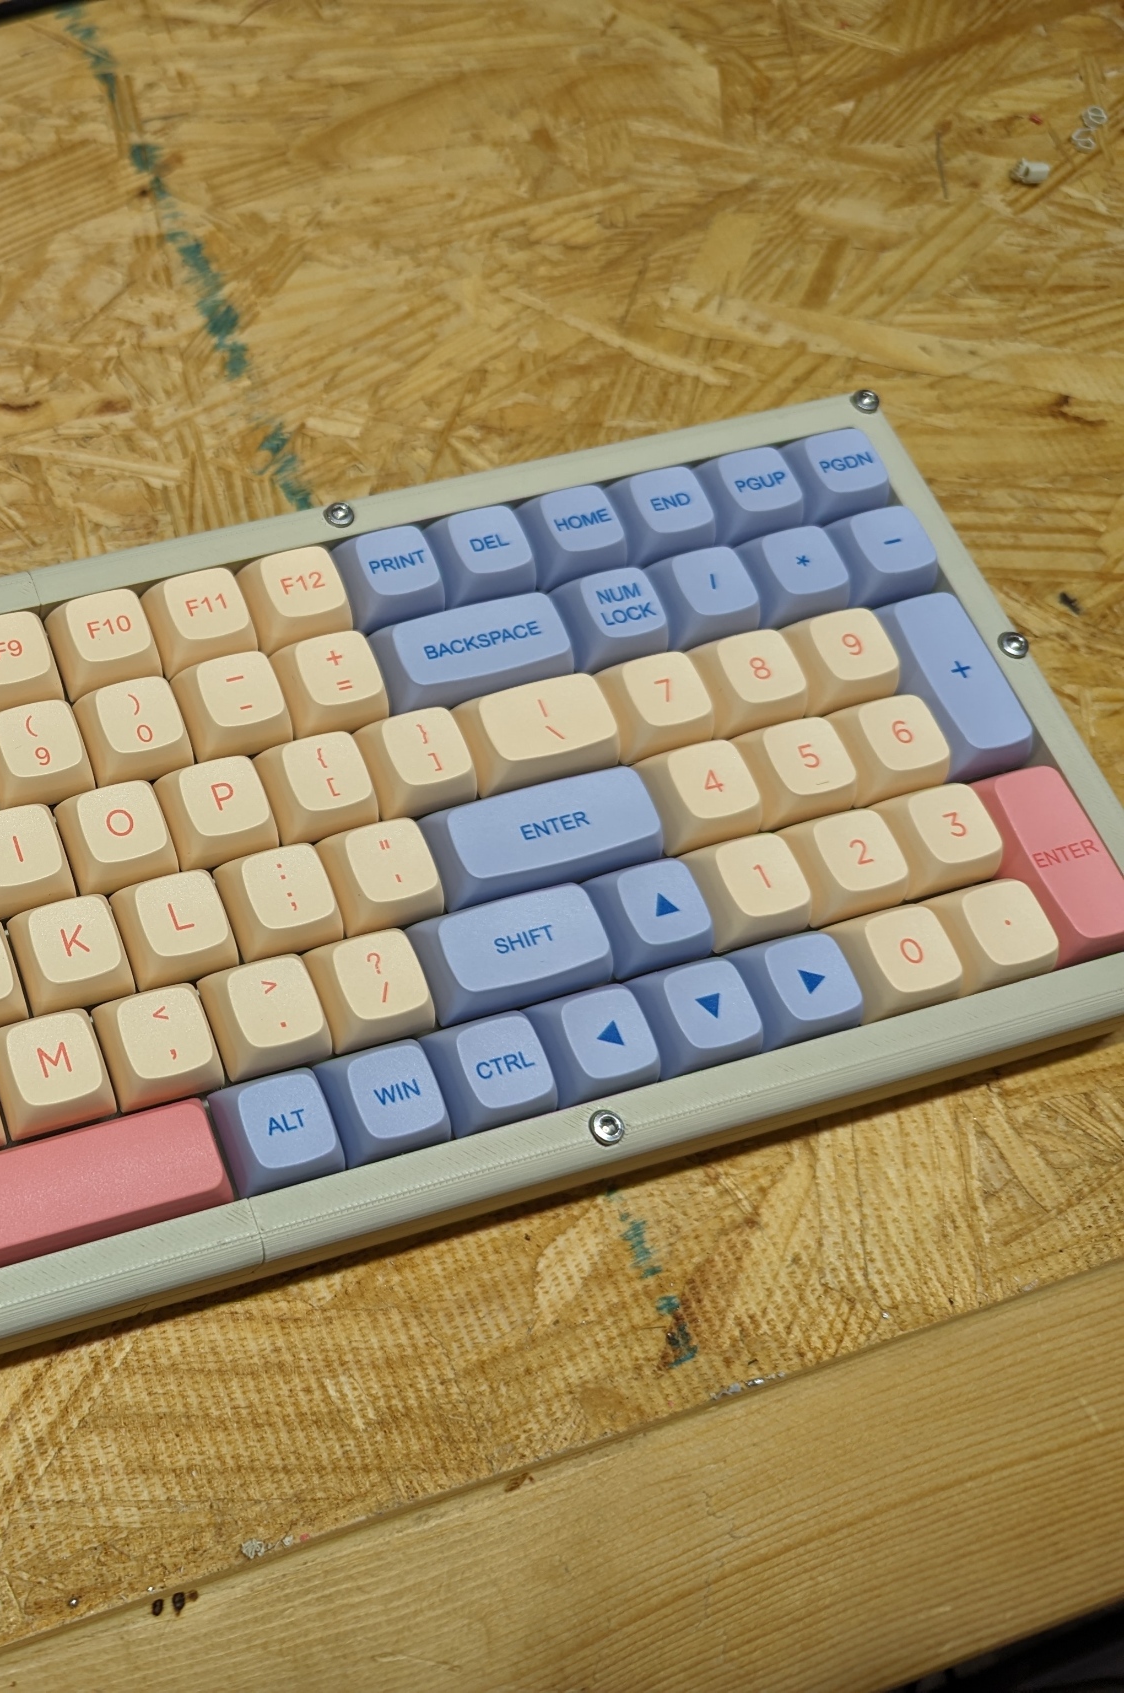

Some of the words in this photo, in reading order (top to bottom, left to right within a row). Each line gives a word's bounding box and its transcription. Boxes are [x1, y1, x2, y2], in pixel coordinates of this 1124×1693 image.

[818, 451, 874, 474] PGDN
[735, 470, 786, 493] PGUP
[649, 492, 692, 512] END
[553, 507, 612, 532] HOME
[469, 533, 511, 553] DEL
[368, 549, 426, 575] PRINT
[279, 571, 326, 596] F12
[595, 582, 642, 606] NUM
[185, 593, 227, 618] F11
[601, 601, 656, 627] LOCK
[86, 614, 132, 640] F10
[423, 620, 542, 661] BACKSPACE
[841, 633, 864, 656] 9
[326, 650, 343, 666] +
[749, 656, 772, 680] 8
[950, 660, 971, 679] +
[336, 679, 353, 691] =
[653, 678, 671, 703] 7
[127, 693, 140, 716] )
[25, 714, 39, 738] (
[415, 723, 429, 745] }
[891, 720, 914, 744] 6
[34, 746, 51, 766] 9
[316, 746, 328, 769] {
[427, 752, 443, 772] ]
[797, 743, 821, 769] 5
[326, 777, 341, 797] [
[704, 769, 725, 793] 4
[210, 782, 234, 812] P
[105, 809, 134, 837] O
[519, 811, 591, 841] ENTER
[942, 811, 967, 838] 3
[12, 835, 24, 863] I
[849, 839, 875, 866] 2
[1031, 837, 1100, 870] ENTER
[752, 863, 772, 889] 1
[167, 902, 195, 932] L
[59, 923, 91, 958] K
[493, 924, 553, 955] SHIFT
[366, 952, 382, 975] ?
[260, 980, 278, 995] >
[152, 1005, 170, 1020] <
[36, 1041, 73, 1079] M
[475, 1050, 536, 1080] CTRL
[373, 1078, 421, 1106] WIN
[268, 1108, 305, 1137] ALT
